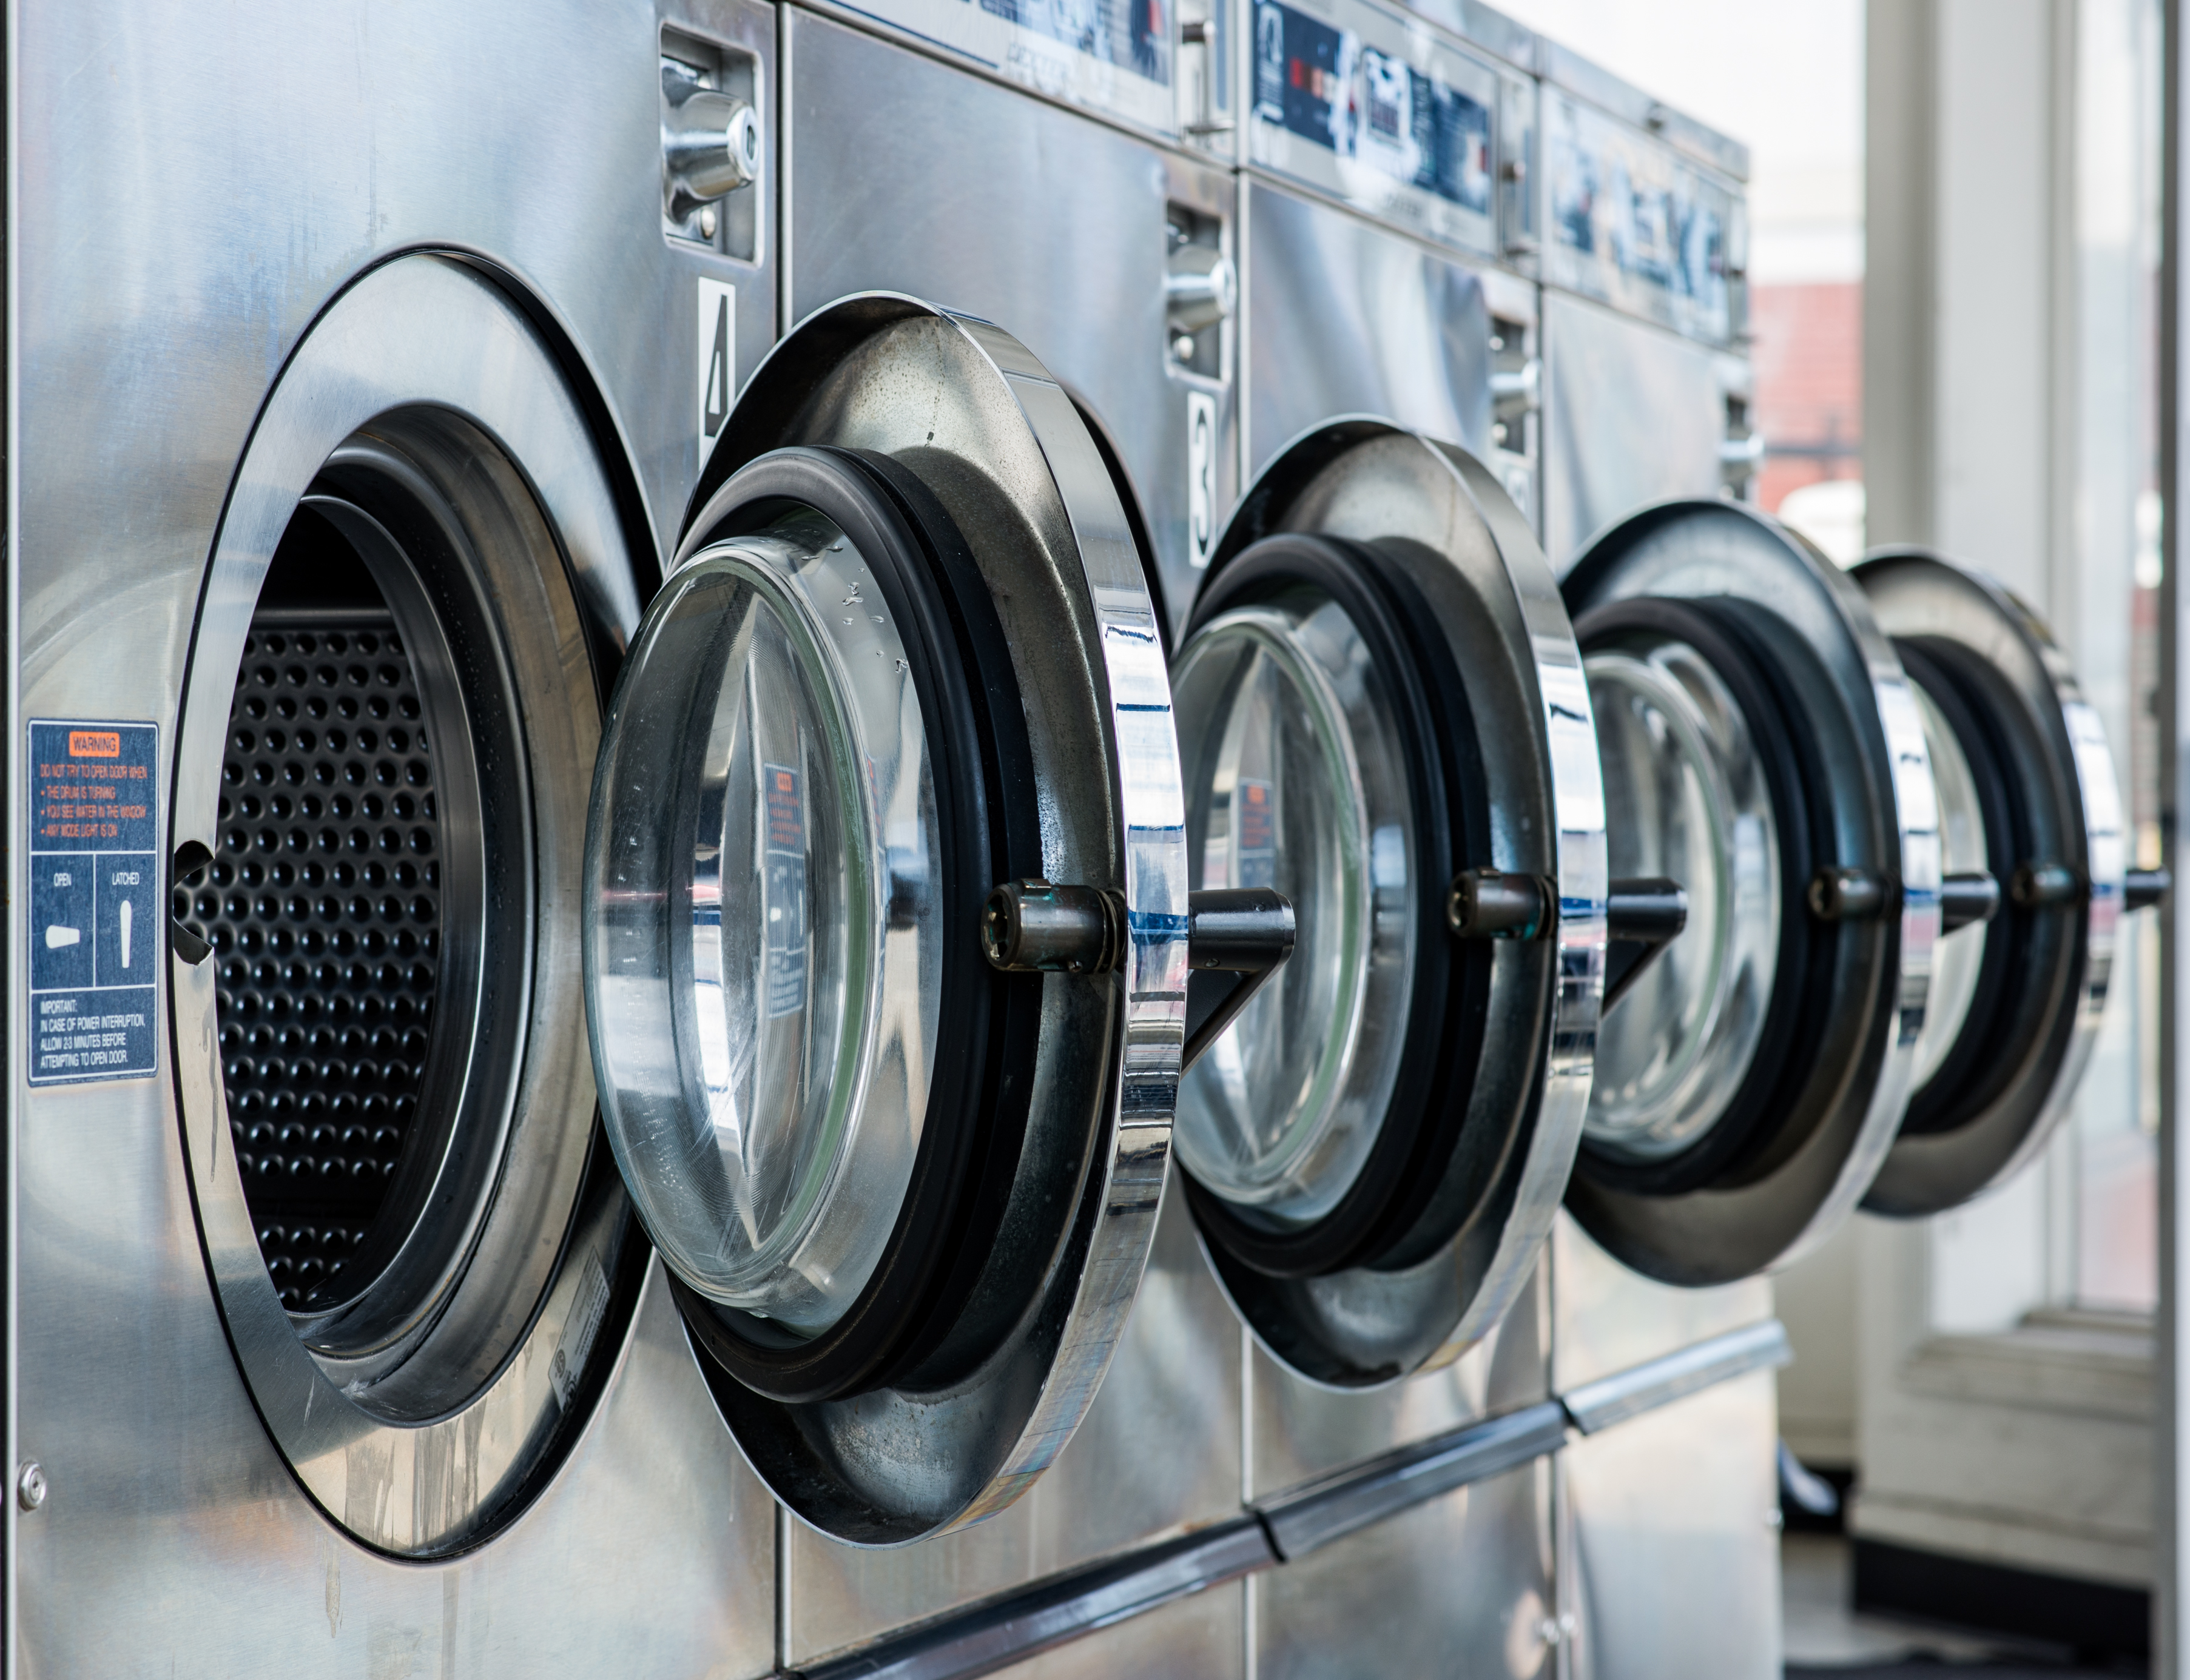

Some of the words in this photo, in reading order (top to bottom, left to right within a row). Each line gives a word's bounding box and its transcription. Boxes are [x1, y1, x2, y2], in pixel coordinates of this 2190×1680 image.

[705, 294, 728, 438] 4
[1196, 408, 1210, 556] 3
[73, 736, 116, 752] WARNING
[40, 764, 50, 778] DO
[52, 764, 65, 778] NOT
[67, 764, 79, 778] TRY
[81, 765, 90, 778] TO
[91, 765, 108, 778] OPEN
[109, 765, 127, 779] DOOR
[129, 766, 147, 779] WHEN
[46, 785, 59, 799] THE
[61, 785, 79, 799] DRUM
[81, 786, 87, 799] IS
[88, 786, 116, 799] TURNING
[46, 805, 60, 818] YOU
[61, 805, 74, 818] SEE
[76, 805, 97, 818] WATER
[98, 805, 105, 818] IN
[107, 805, 119, 818] THE
[120, 805, 146, 818] WINDOW
[46, 824, 59, 837] ANY
[61, 824, 79, 837] MODE
[81, 824, 99, 837] LIGHT
[100, 824, 106, 837] IS
[107, 824, 118, 837] ON
[53, 873, 72, 886] OPEN
[112, 872, 140, 885] LATCHED
[40, 999, 78, 1014] IMPORTANT:
[40, 1020, 48, 1032] IN
[49, 1018, 66, 1032] CASE
[66, 1017, 76, 1031] OF
[77, 1016, 100, 1030] POWER
[101, 1013, 146, 1029] INTERRUPTION,
[40, 1037, 62, 1051] ALLOW
[73, 1033, 101, 1049] MINUTES
[102, 1032, 126, 1047] BEFORE
[40, 1053, 79, 1069] ATTEMPTING
[80, 1052, 90, 1066] TO
[90, 1051, 108, 1066] OPEN
[109, 1050, 128, 1064] DOOR.
